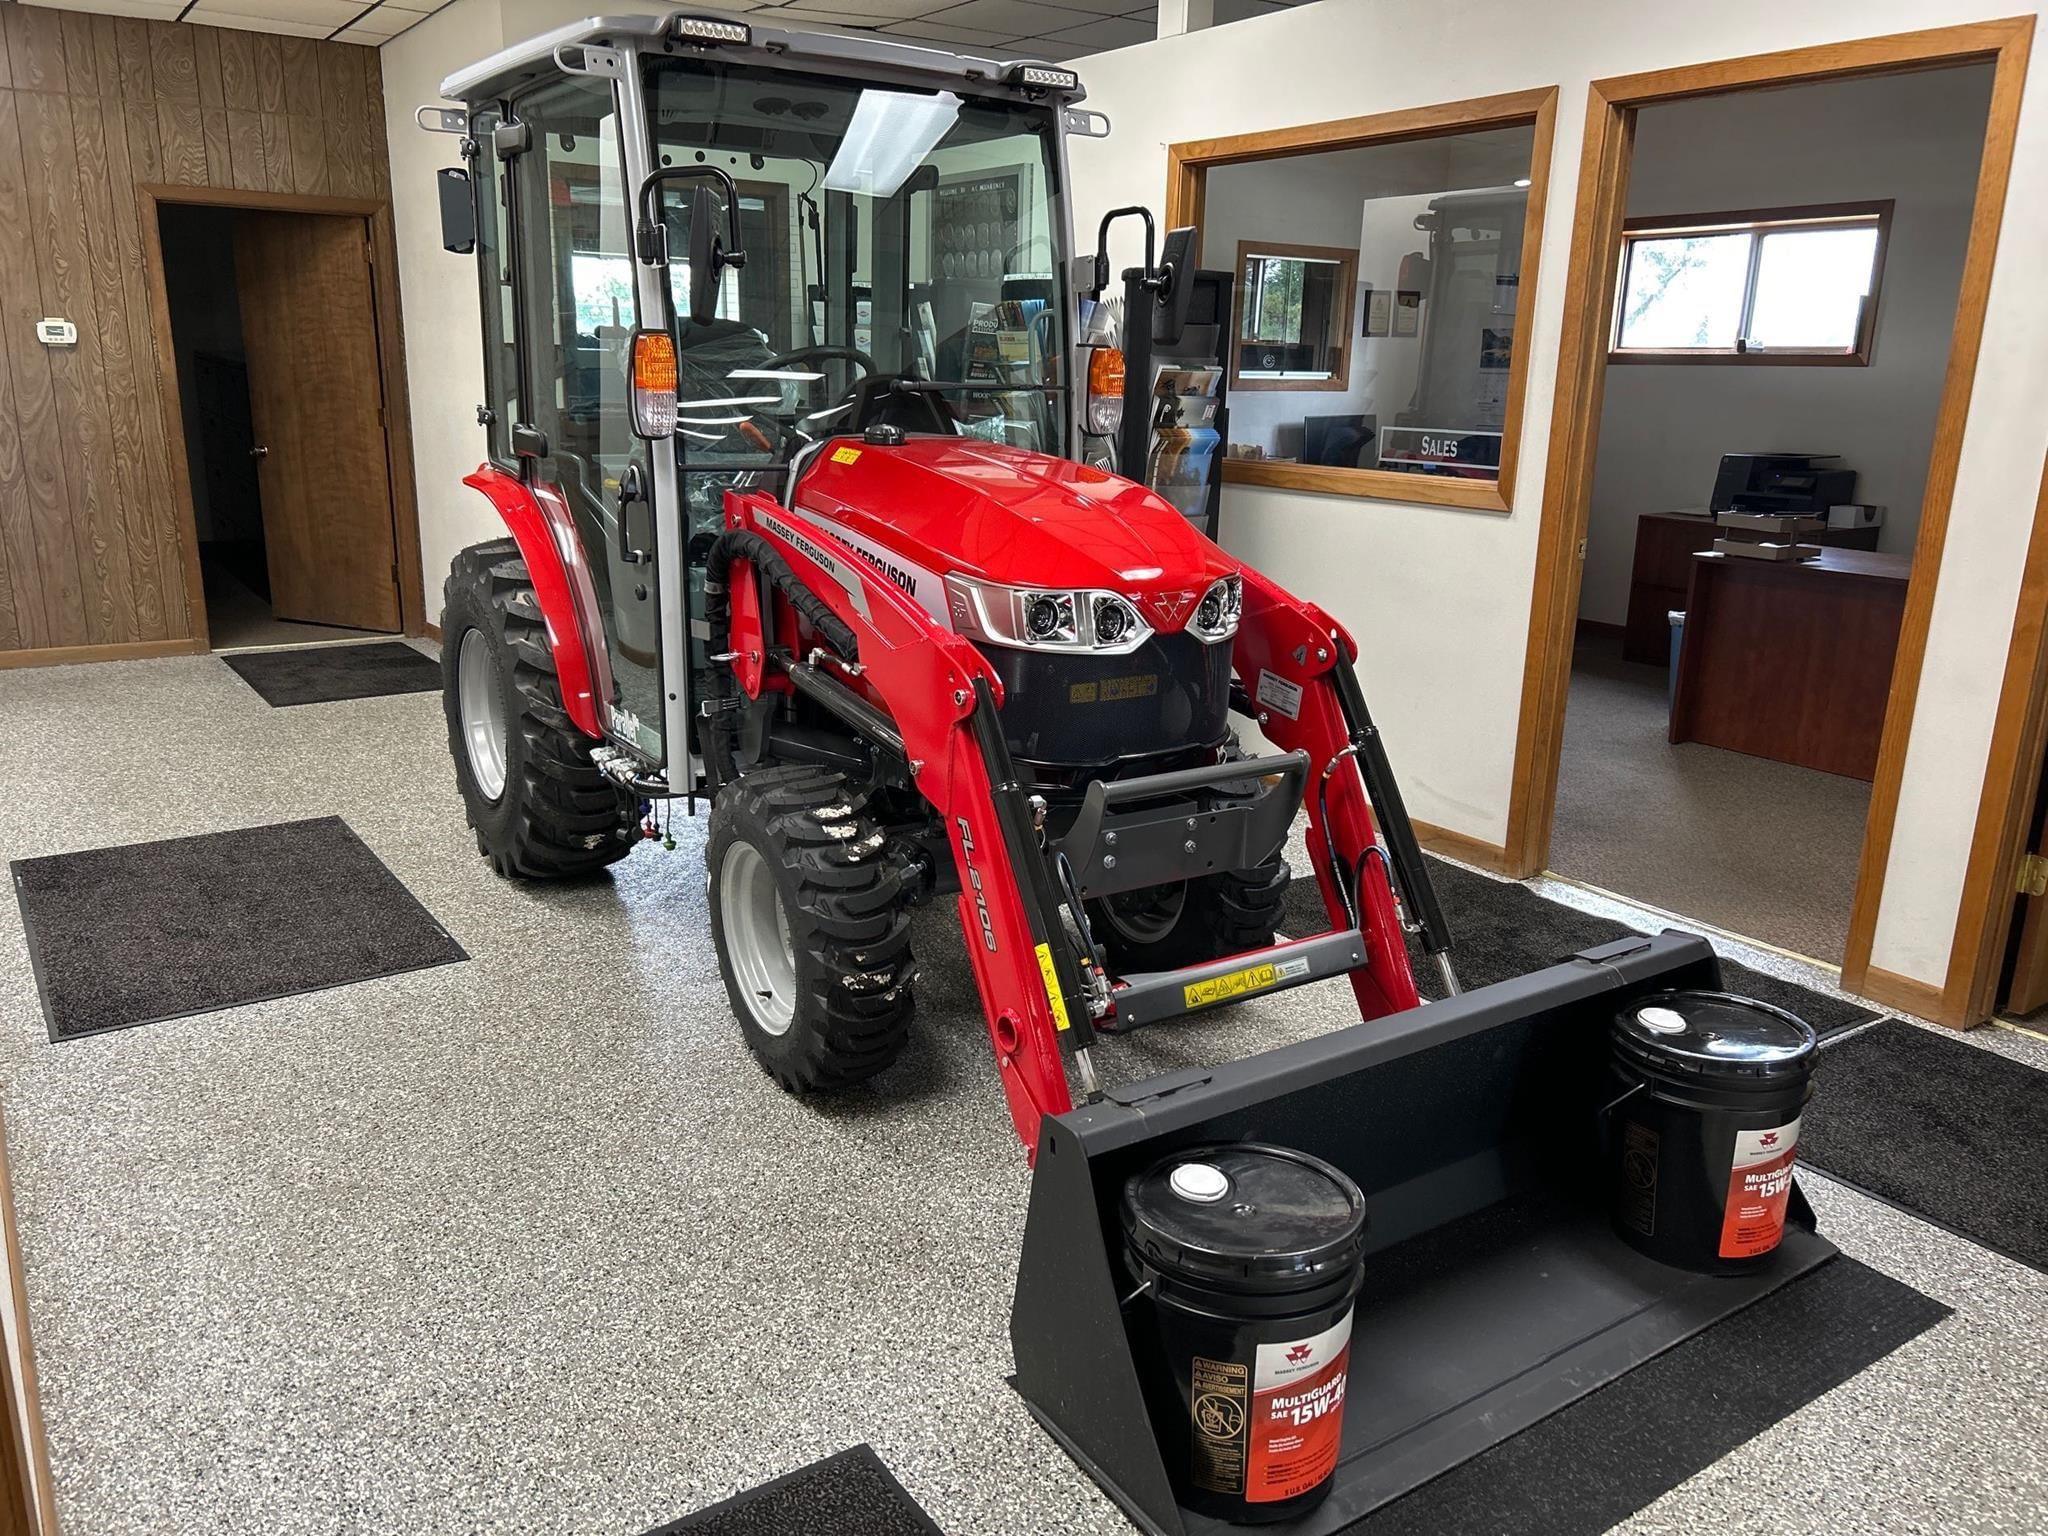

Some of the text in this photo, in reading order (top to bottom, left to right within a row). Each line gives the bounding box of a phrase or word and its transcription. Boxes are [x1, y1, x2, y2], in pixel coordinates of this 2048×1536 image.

[766, 517, 794, 541] MASSEY
[795, 535, 836, 573] FERGUSON
[1202, 1360, 1245, 1375] WARNING
[1202, 1371, 1229, 1384] AVISO
[1271, 1371, 1343, 1410] MULTIGUARD
[1271, 1410, 1289, 1420] SAE
